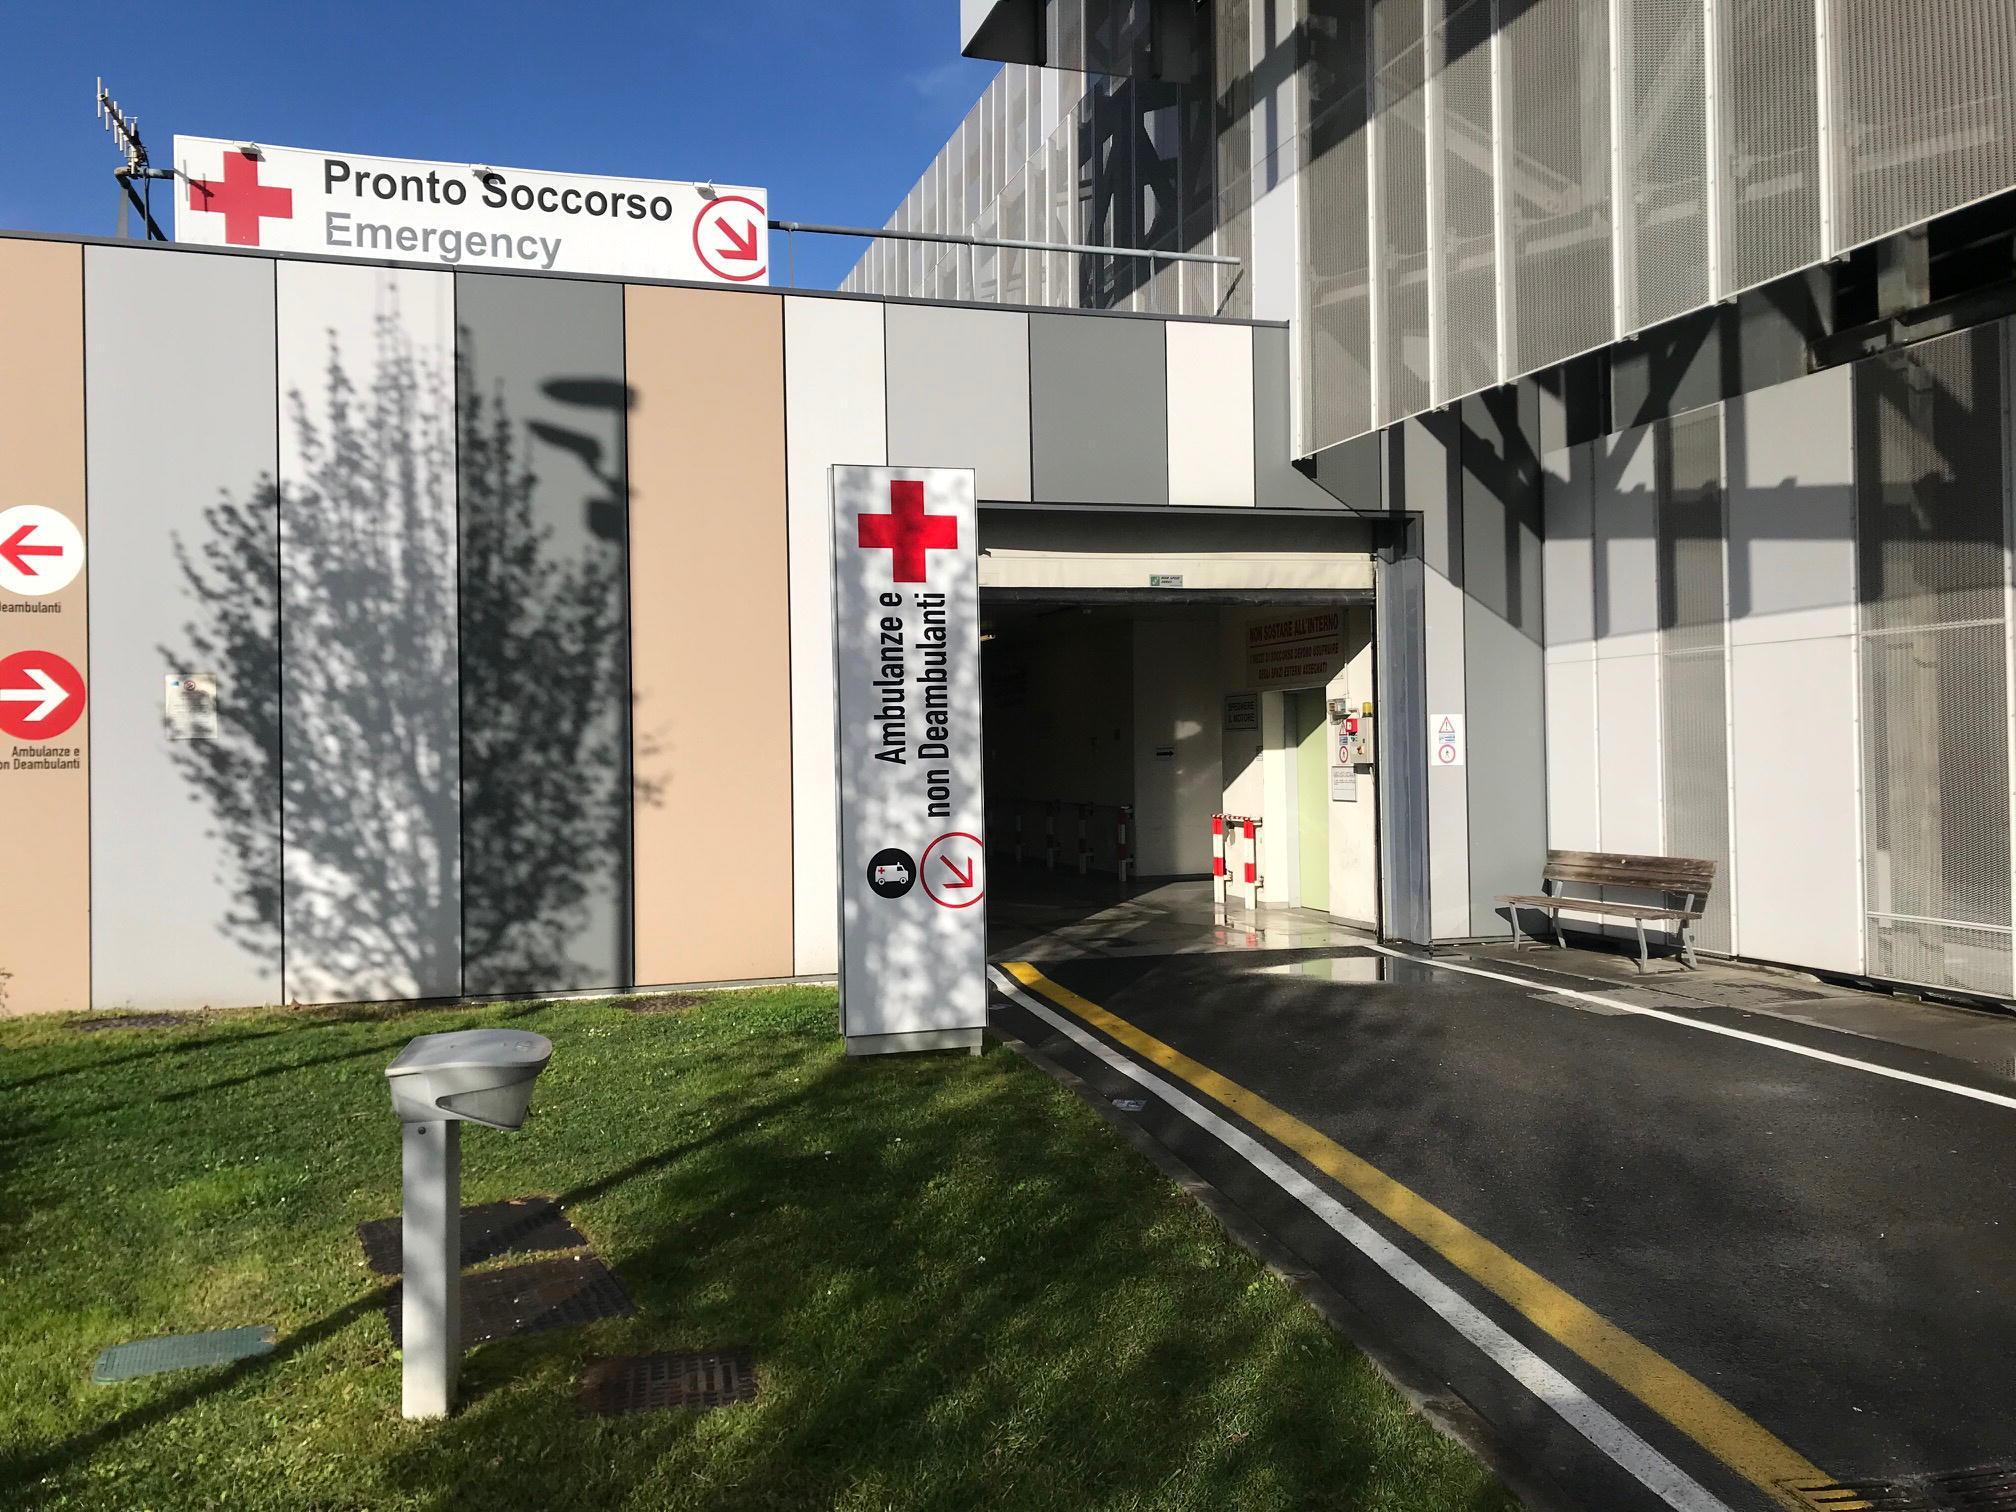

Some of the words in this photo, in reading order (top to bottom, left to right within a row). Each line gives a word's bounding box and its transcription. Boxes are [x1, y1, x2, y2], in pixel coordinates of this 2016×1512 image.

[324, 159, 466, 205] Pronto
[482, 173, 673, 221] Soccorso
[326, 211, 562, 269] Emergency
[0, 601, 62, 613] eambulanti
[879, 592, 902, 607] e
[1249, 626, 1263, 642] NON
[1263, 621, 1293, 641] SOSTARE
[1294, 613, 1339, 636] ALL'INTERNO
[873, 616, 906, 765] Ambulanze
[914, 593, 950, 760] Deambulanti
[12, 746, 70, 757] Ambulanze
[73, 748, 80, 756] e
[13, 758, 80, 770] Deambulanti
[927, 769, 950, 817] non
